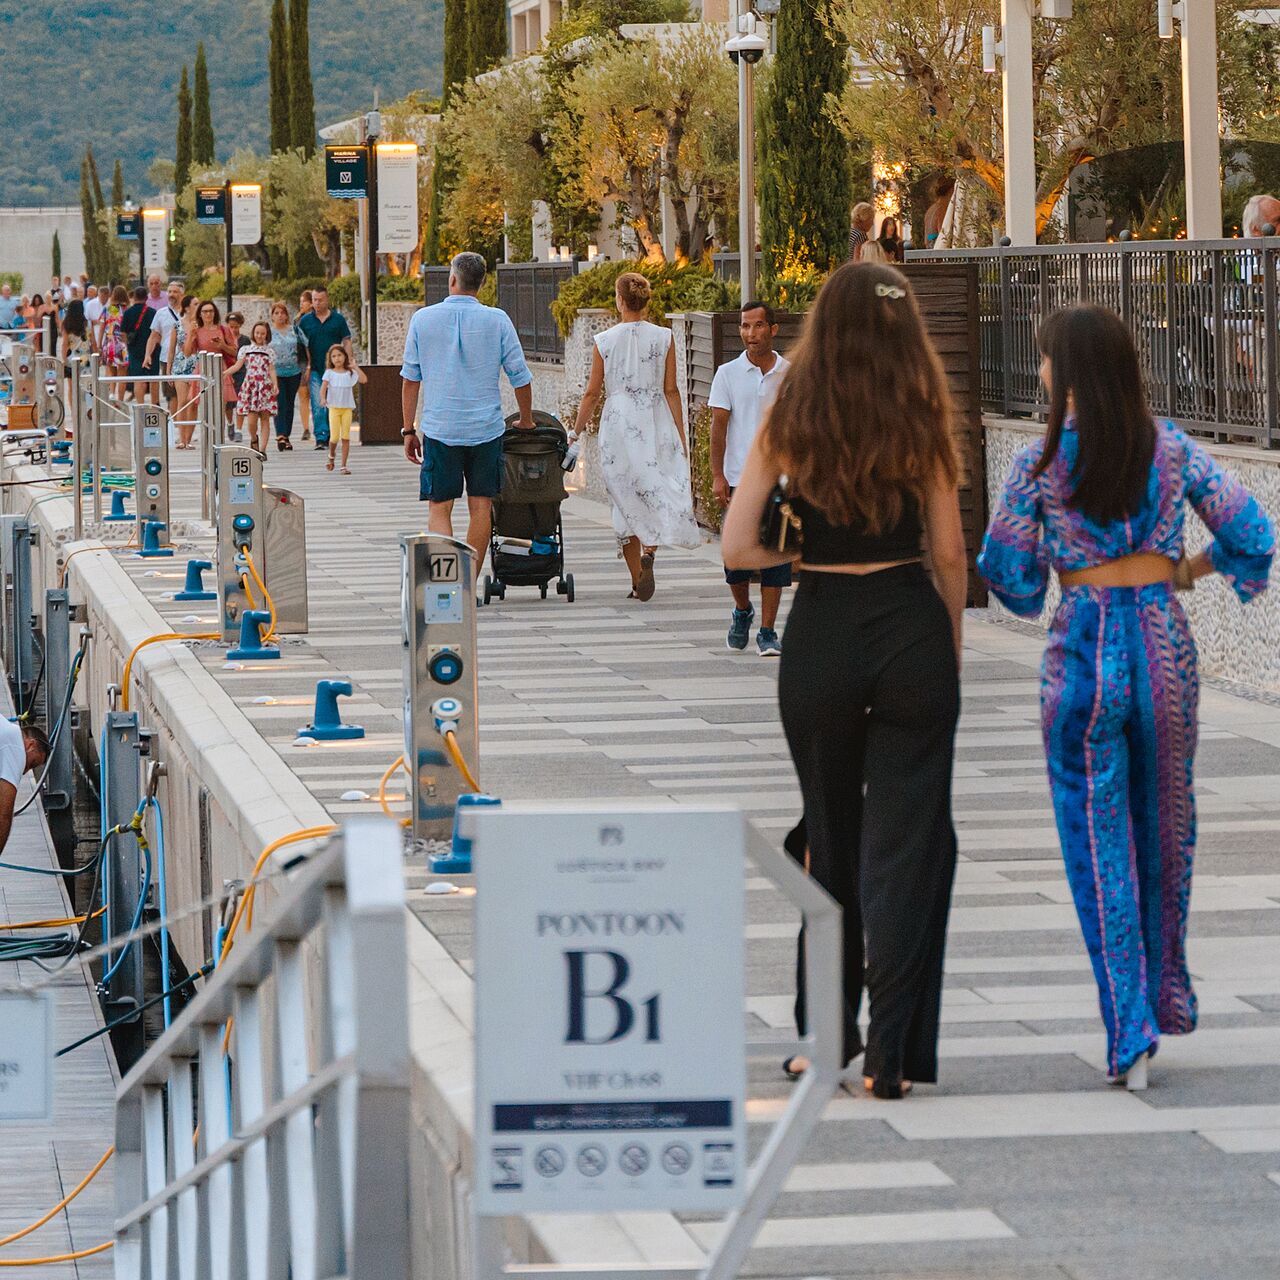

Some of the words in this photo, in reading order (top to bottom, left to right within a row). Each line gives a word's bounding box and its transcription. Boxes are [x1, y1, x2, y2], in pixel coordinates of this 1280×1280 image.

[146, 416, 158, 425] 13
[234, 460, 249, 474] 15
[431, 558, 455, 577] 17
[535, 911, 685, 938] PONTOON
[564, 947, 662, 1045] B1
